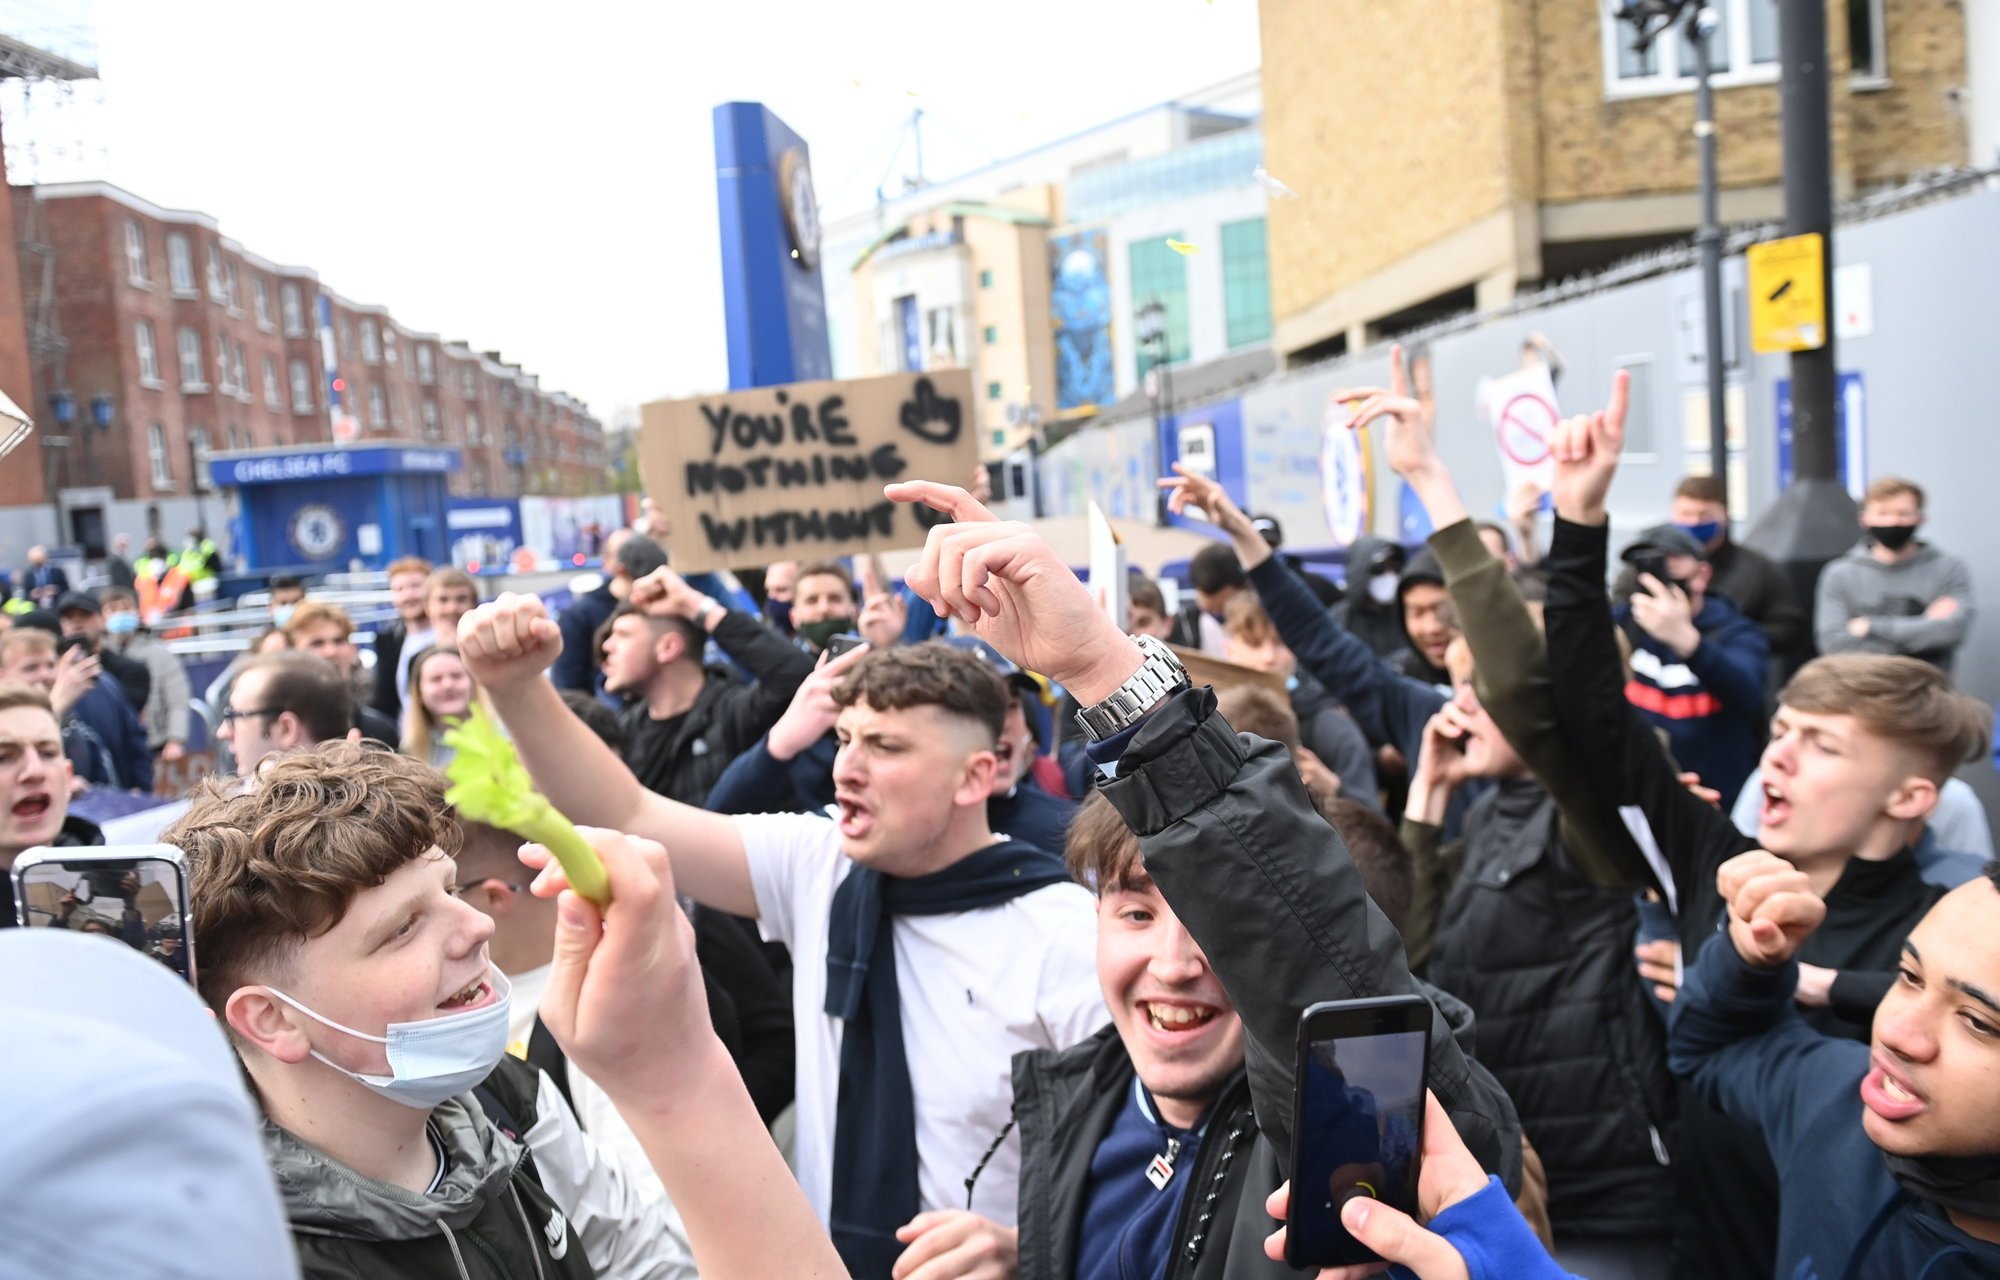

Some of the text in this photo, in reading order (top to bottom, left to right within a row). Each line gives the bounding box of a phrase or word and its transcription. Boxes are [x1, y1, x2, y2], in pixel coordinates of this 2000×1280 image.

[234, 451, 352, 483] CHELSEA FC
[685, 443, 906, 496] NOTHING
[699, 501, 895, 550] WITHOUT
